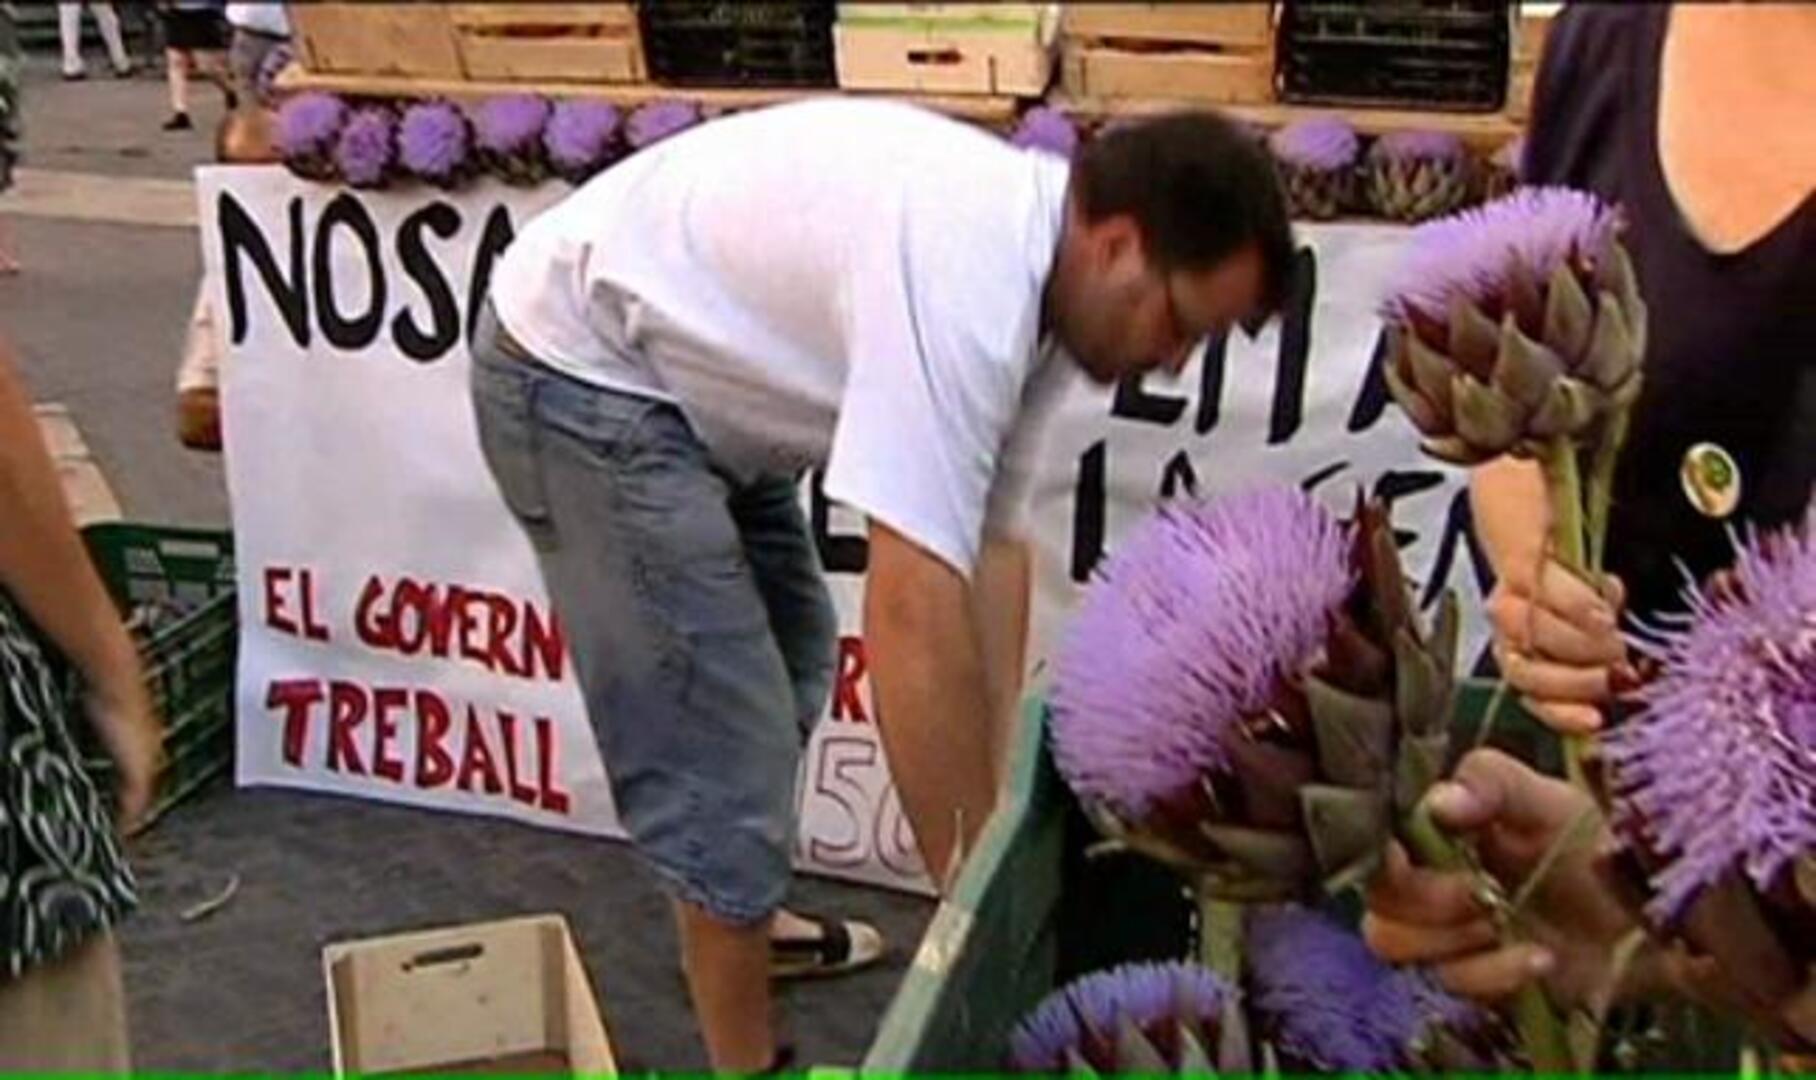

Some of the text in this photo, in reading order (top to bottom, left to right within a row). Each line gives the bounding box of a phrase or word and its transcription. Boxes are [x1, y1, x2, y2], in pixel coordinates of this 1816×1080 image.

[264, 567, 566, 681] EL GOVERN
[265, 678, 570, 815] TREBALL
